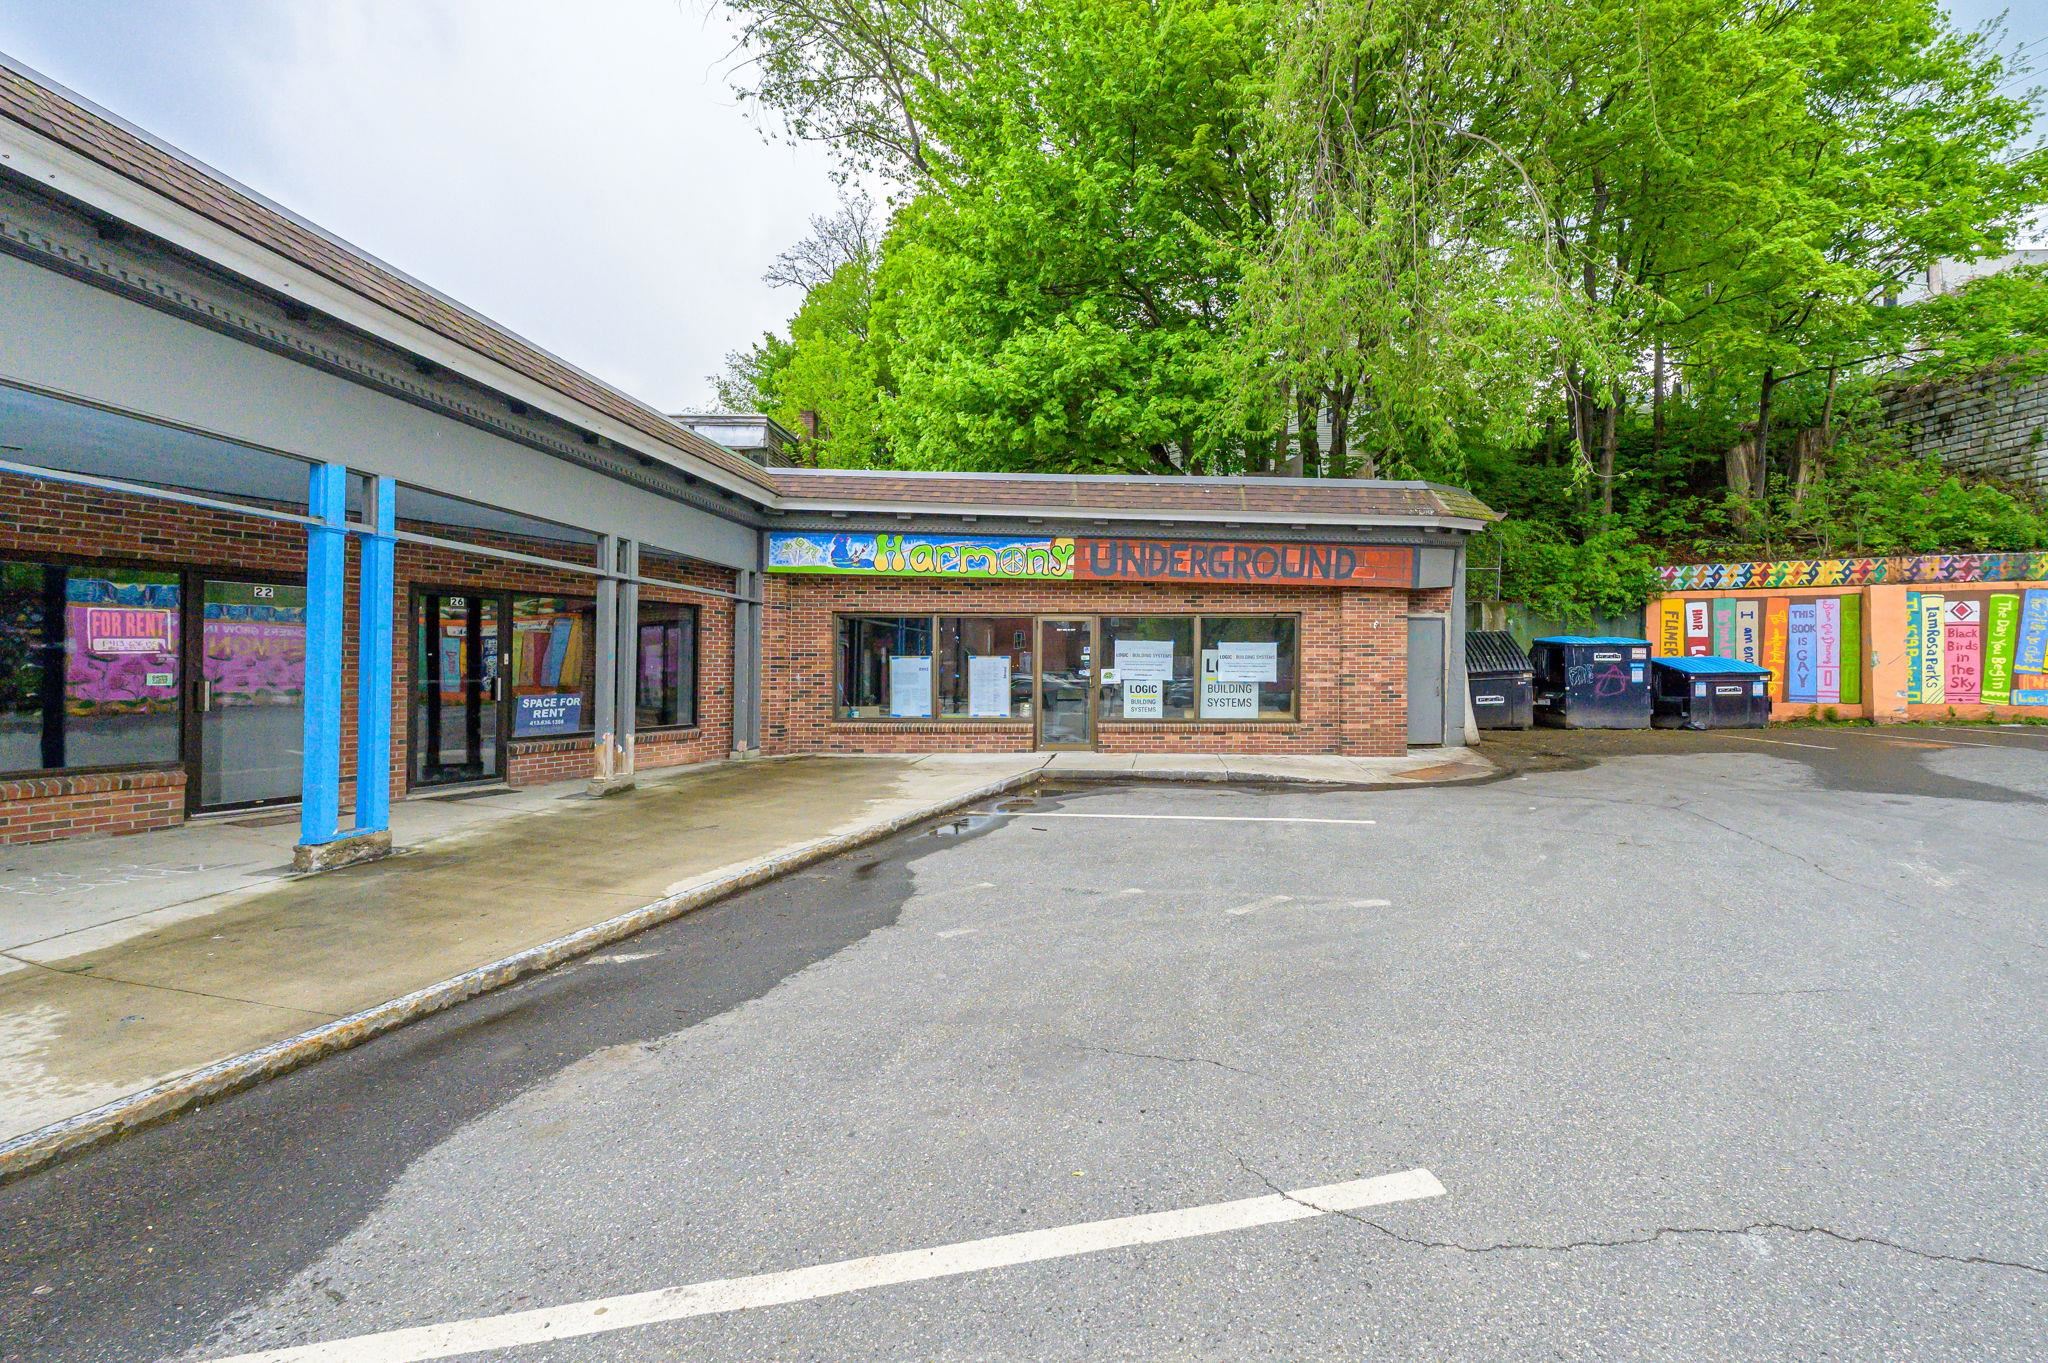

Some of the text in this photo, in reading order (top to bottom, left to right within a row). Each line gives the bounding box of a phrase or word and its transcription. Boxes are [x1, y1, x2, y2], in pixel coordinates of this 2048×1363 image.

[1088, 541, 1357, 580] UNDERGROUND
[255, 587, 272, 596] 22
[451, 598, 463, 606] 26
[1741, 611, 1754, 619] I
[1792, 610, 1814, 618] THIS
[92, 611, 165, 636] FOR RENT
[1691, 609, 1704, 631] HAIR
[1664, 611, 1680, 656] FLAMER
[1792, 624, 1816, 633] BOOK
[1947, 627, 1978, 638] Black
[1743, 627, 1752, 644] am
[1798, 637, 1808, 645] IS
[1947, 641, 1978, 651] Birds
[1988, 600, 2012, 689] The Day You Begin
[1956, 653, 1970, 662] in
[1796, 649, 1810, 688] GAY
[1129, 685, 1158, 694] LOGIC
[1207, 684, 1252, 694] BUILDING
[1950, 677, 1976, 692] Sky
[522, 697, 580, 708] SPACE FOR
[1207, 698, 1252, 708] SYSTEMS
[532, 708, 566, 718] RENT
